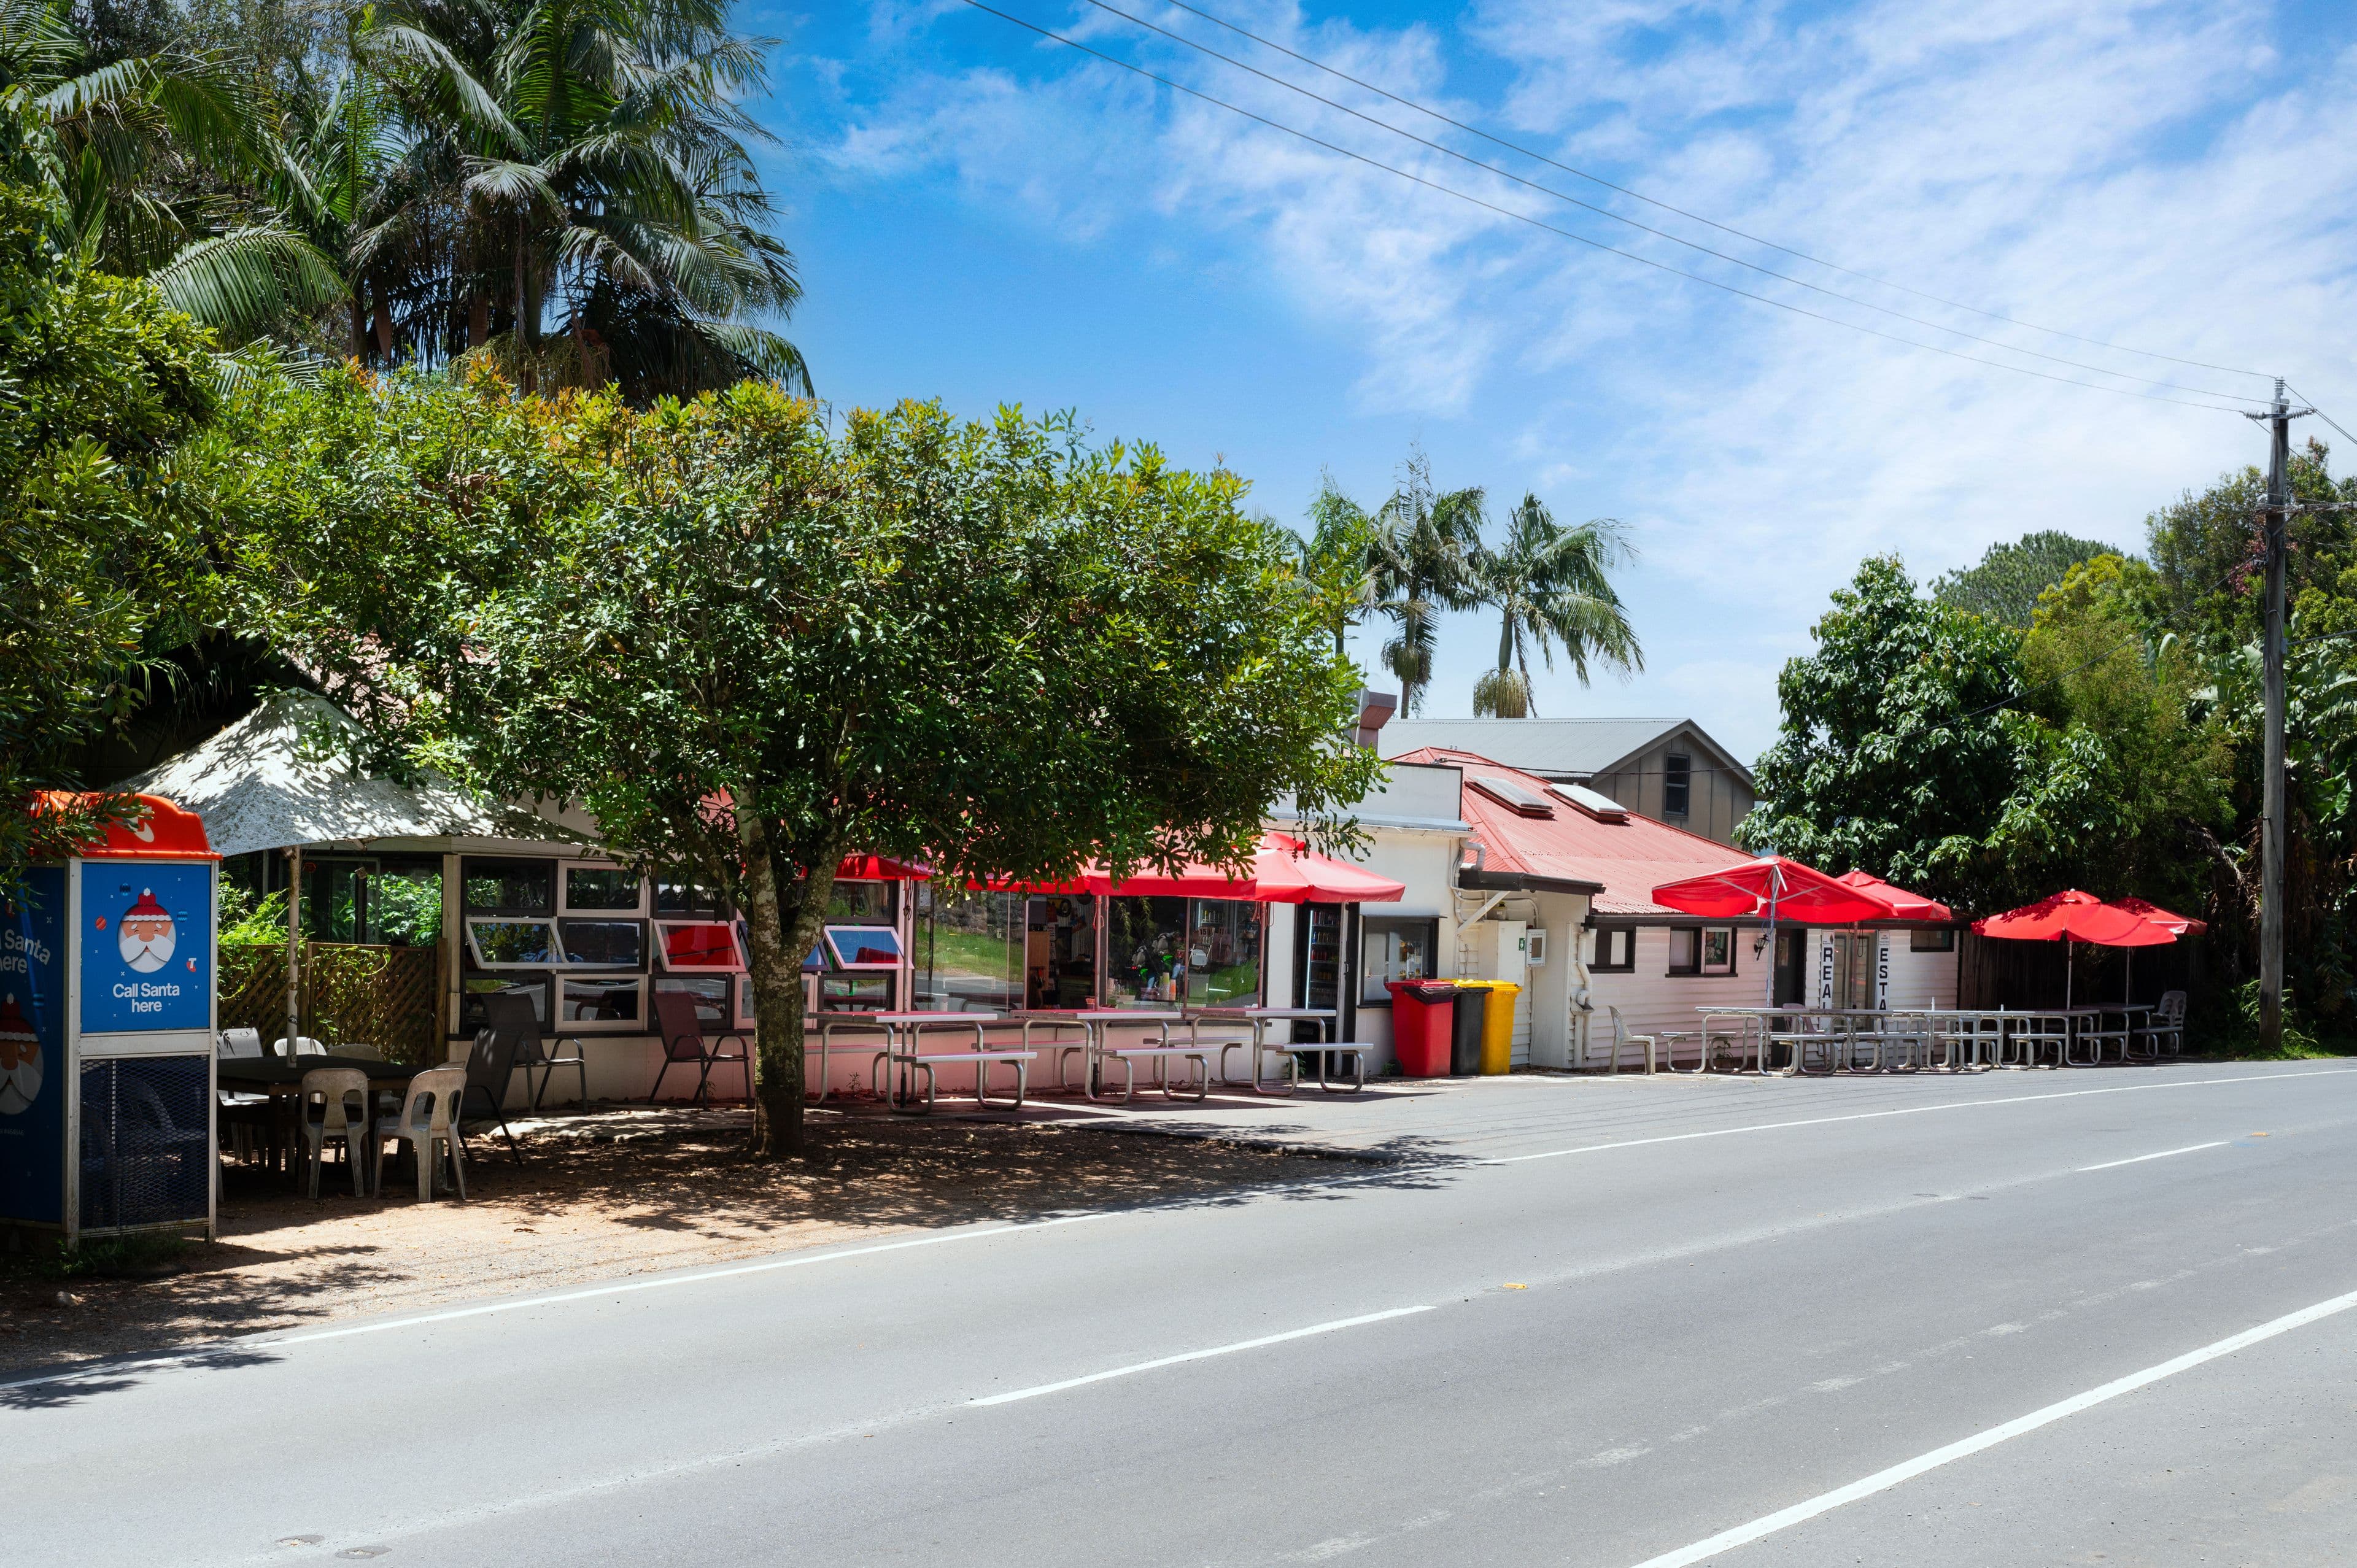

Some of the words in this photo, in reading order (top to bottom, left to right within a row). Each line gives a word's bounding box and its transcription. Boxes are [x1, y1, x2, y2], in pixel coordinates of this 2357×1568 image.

[4, 929, 50, 965] Santa
[112, 983, 139, 998] Call
[141, 983, 180, 997] Santa
[131, 998, 163, 1013] here
